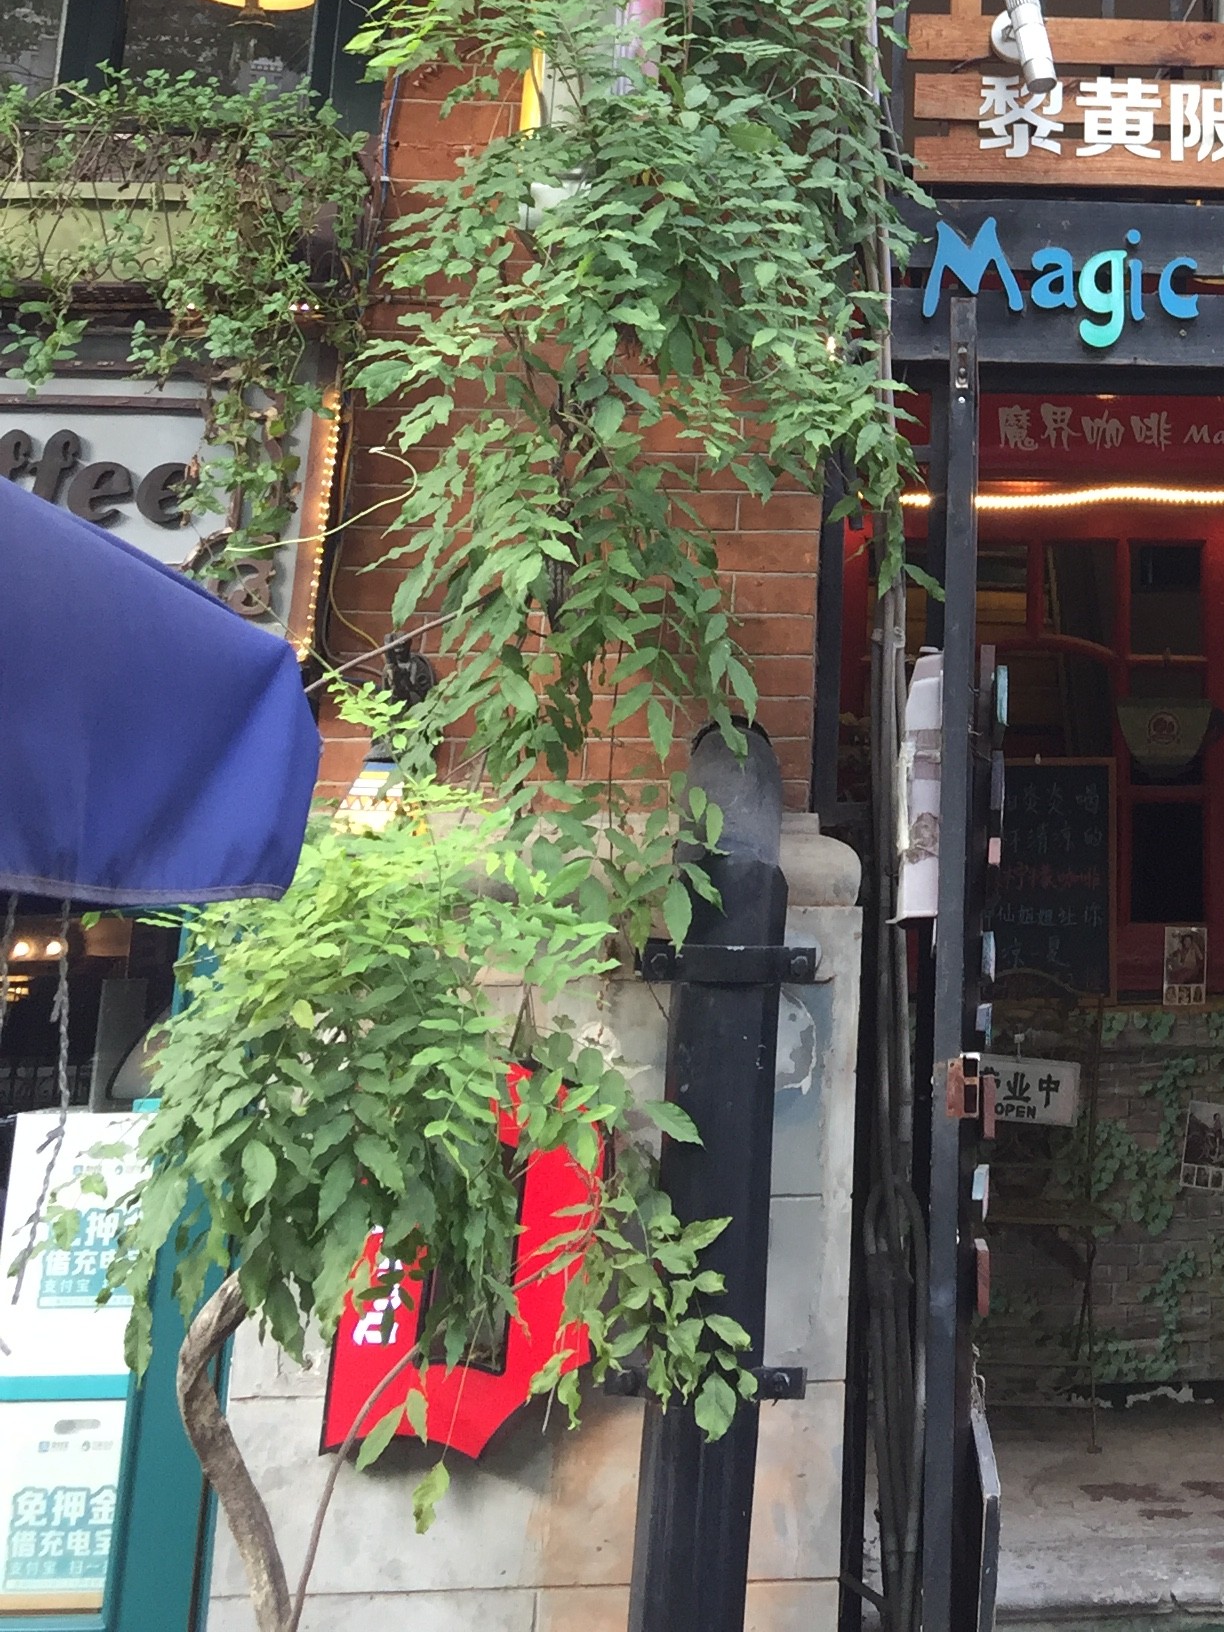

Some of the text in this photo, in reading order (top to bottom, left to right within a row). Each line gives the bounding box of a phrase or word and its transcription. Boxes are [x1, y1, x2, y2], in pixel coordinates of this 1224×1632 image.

[922, 215, 1200, 348] Magic
[998, 403, 1173, 451] 魔界咖啡
[994, 1102, 1037, 1120] OPEN
[14, 1487, 117, 1527] 免押金
